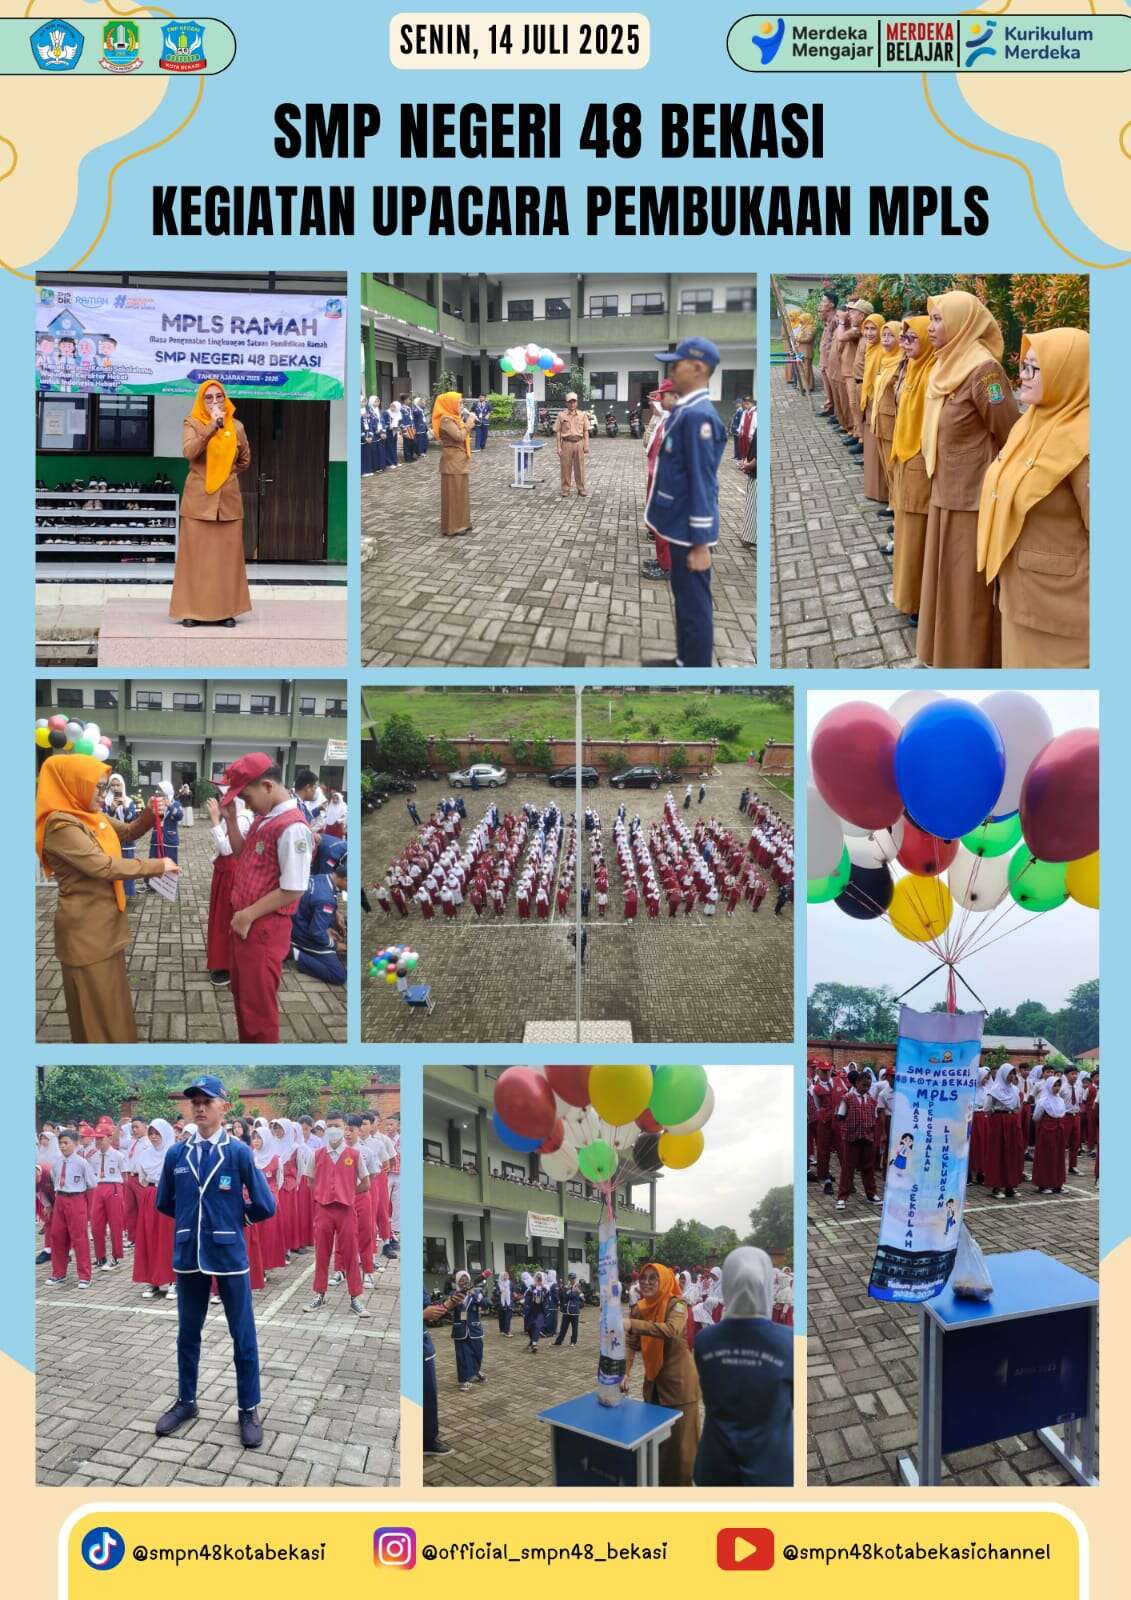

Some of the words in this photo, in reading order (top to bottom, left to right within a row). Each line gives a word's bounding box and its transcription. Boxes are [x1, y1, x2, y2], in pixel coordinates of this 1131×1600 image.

[161, 313, 224, 334] MPLS
[230, 316, 318, 336] RAMAH
[155, 351, 187, 363] SMP
[190, 352, 244, 365] NEGERI
[247, 354, 266, 366] 48
[269, 354, 322, 367] BEKASI
[907, 1066, 931, 1076] SMP
[933, 1069, 970, 1078] NEGERI
[909, 1076, 939, 1087] KOTA
[941, 1078, 977, 1088] BEKASI
[916, 1089, 959, 1102] MPLS
[912, 1101, 920, 1130] MASA
[904, 1184, 919, 1249] SEKOLAH
